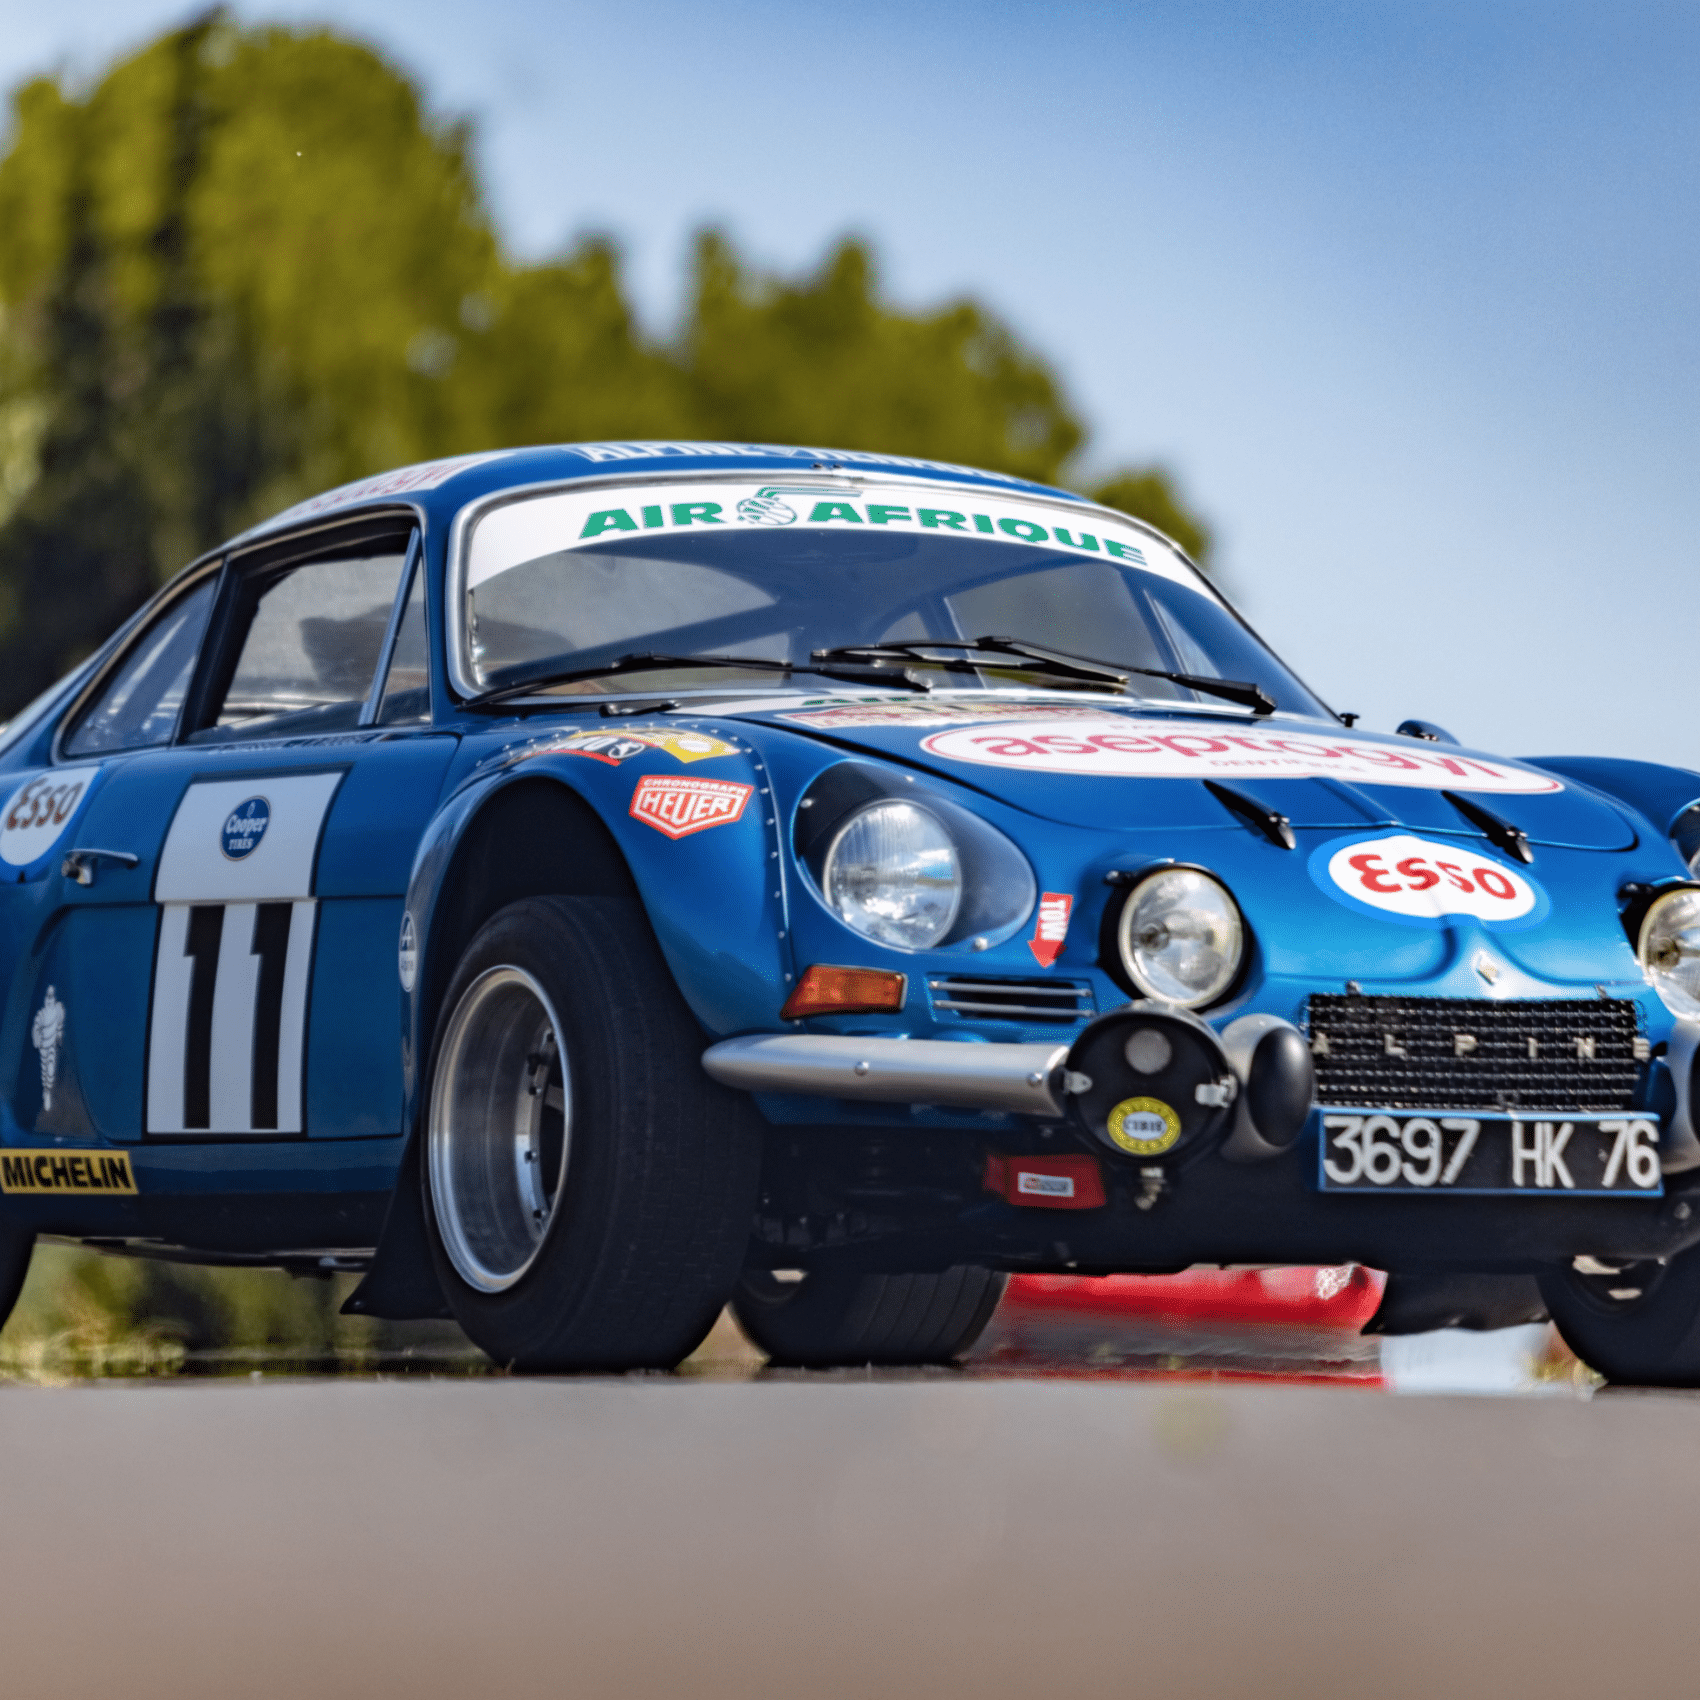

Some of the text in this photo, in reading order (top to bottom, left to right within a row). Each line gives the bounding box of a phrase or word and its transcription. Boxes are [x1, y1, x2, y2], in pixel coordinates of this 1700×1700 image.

[578, 502, 1147, 566] AIR AFRIQUE
[969, 734, 1508, 780] aseptogyl
[643, 778, 748, 796] CHRONOGRAPH
[226, 814, 267, 837] Cooper
[642, 792, 733, 825] HEUER
[1040, 899, 1067, 941] TOW
[183, 901, 294, 1130] 11
[1312, 1022, 1651, 1061] ALPINE
[2, 1155, 132, 1189] MICHELIN
[1323, 1115, 1661, 1189] 3697 HK 76
